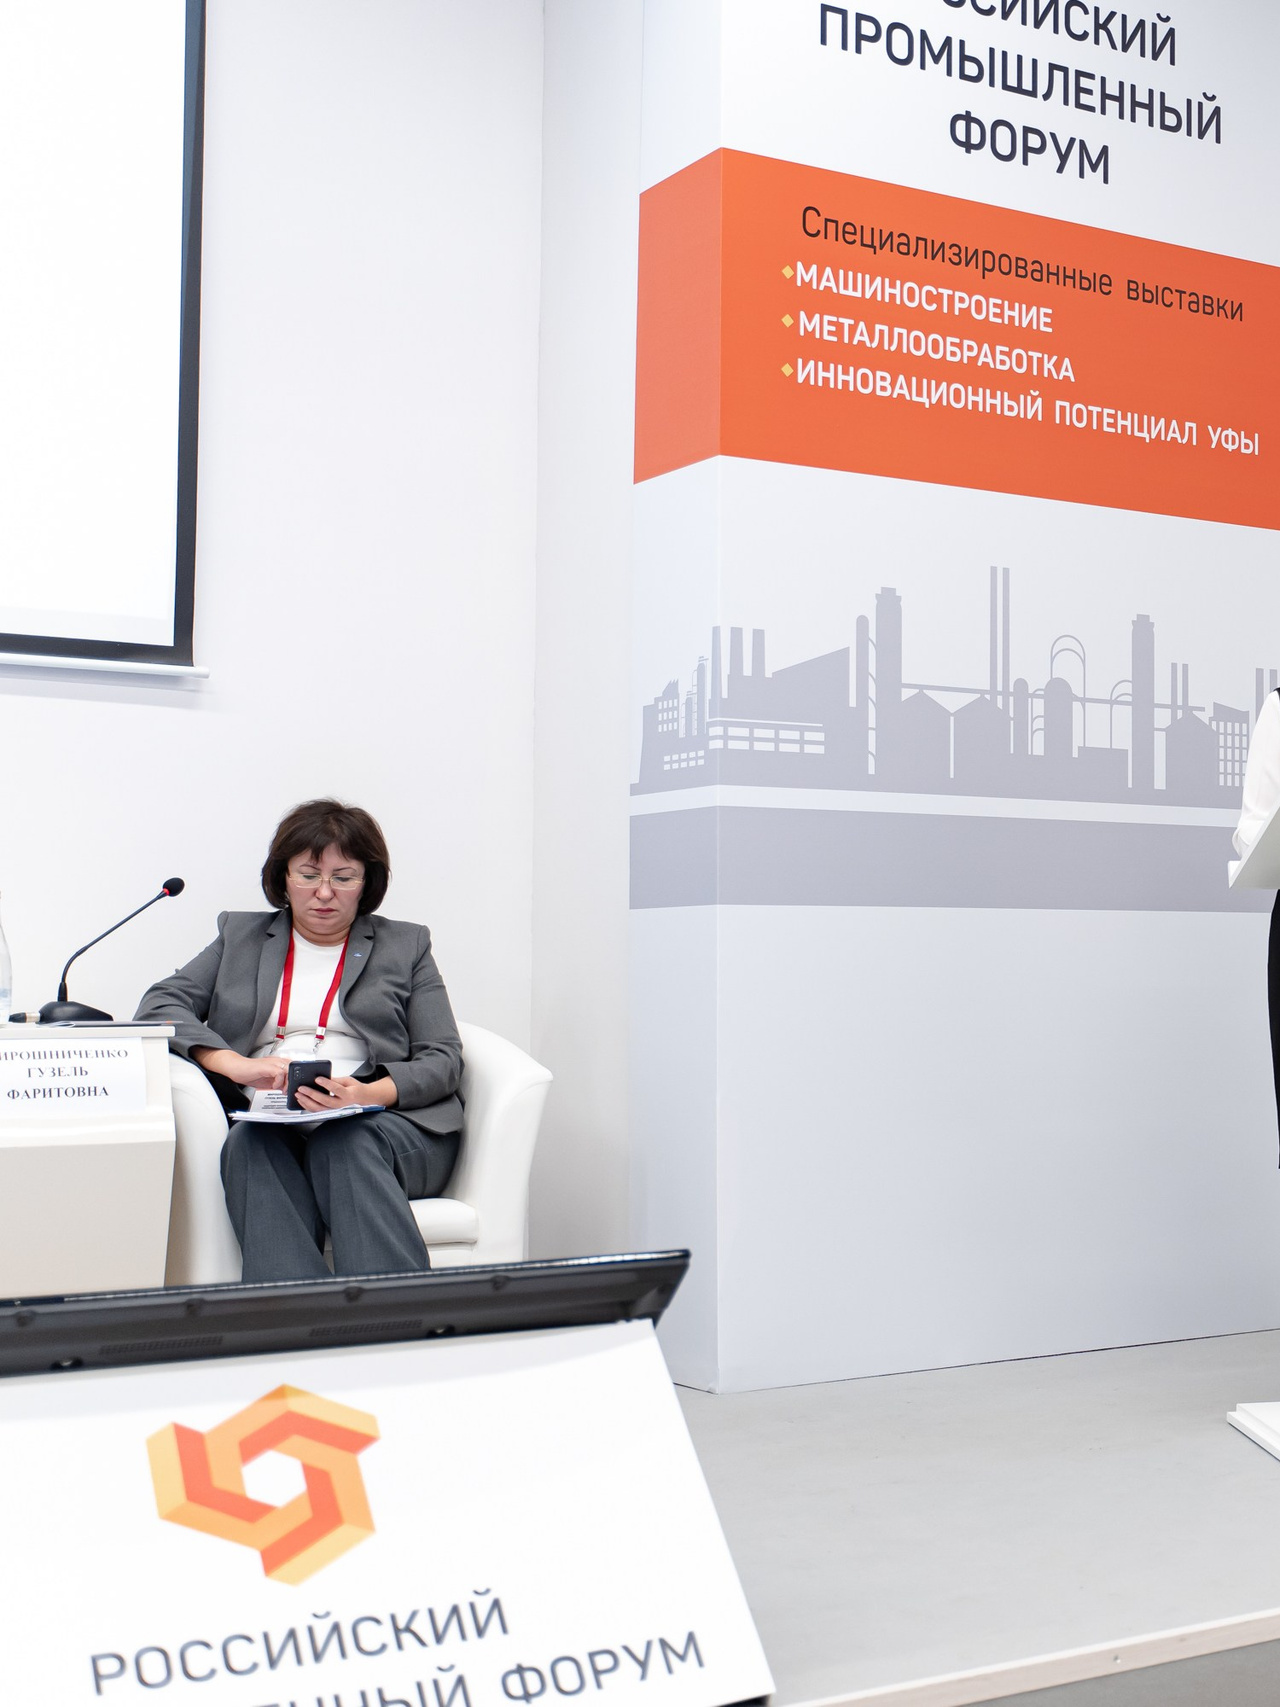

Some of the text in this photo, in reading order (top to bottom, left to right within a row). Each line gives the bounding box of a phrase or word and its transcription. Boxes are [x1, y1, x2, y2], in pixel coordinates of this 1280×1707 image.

[820, 3, 1222, 144] ПРОМЫШЛЕННЫЙ
[949, 110, 1109, 184] ФОРУМ
[796, 261, 1053, 332] МАШИНОСТРОЕНИЕ
[802, 206, 1243, 322] Специализированные выставки
[799, 310, 1075, 382] МЕТАЛЛООБРАБОТКА
[797, 358, 1259, 456] ИННОВАЦИОННЫЙ ПОТЕНЦИАЛ УФЫ
[7, 1086, 109, 1100] ФАРИТОВНА
[27, 1066, 89, 1078] ГУЗЕЛЬ
[90, 1588, 510, 1696] РОССИЙСКИЙ
[501, 1630, 706, 1705] ФОРУМ
